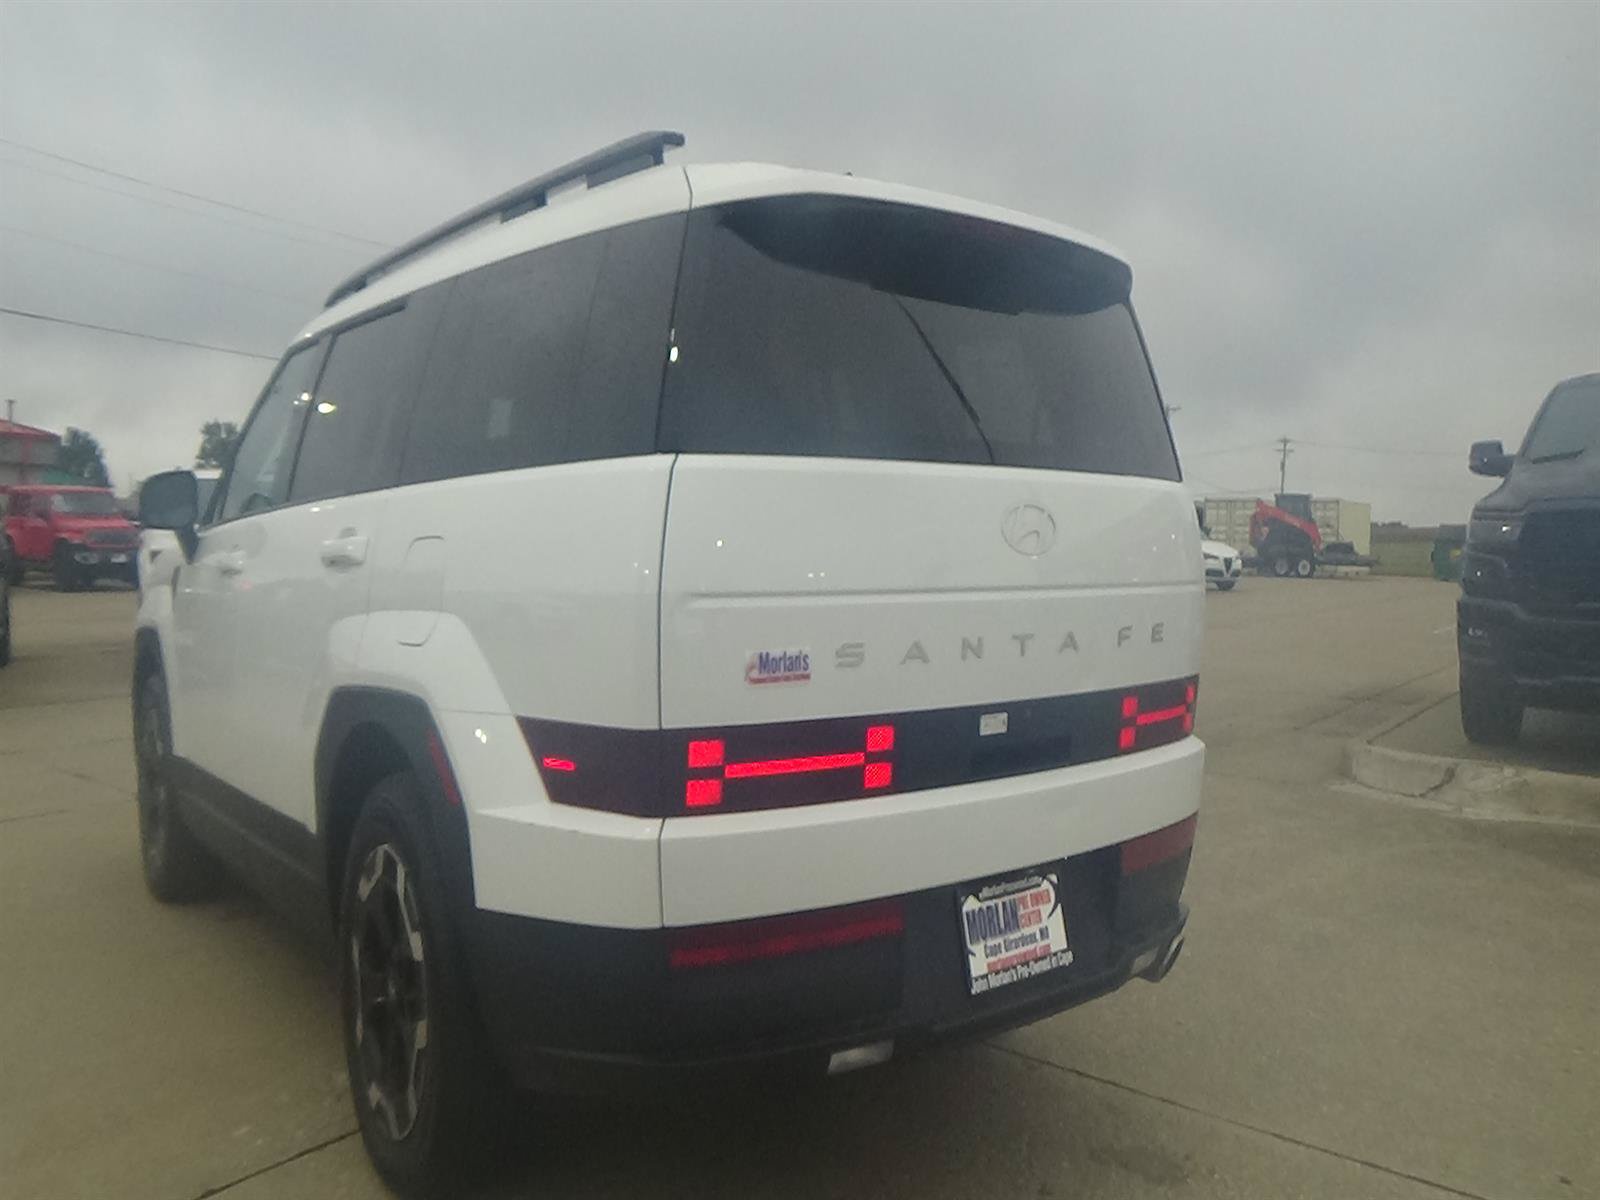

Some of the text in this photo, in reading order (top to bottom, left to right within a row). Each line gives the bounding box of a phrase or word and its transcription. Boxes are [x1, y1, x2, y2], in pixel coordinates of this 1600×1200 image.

[758, 649, 810, 674] Morlan's
[834, 621, 1166, 668] SANTA FE
[965, 898, 1020, 945] MORLAN
[984, 941, 1002, 958] Cape
